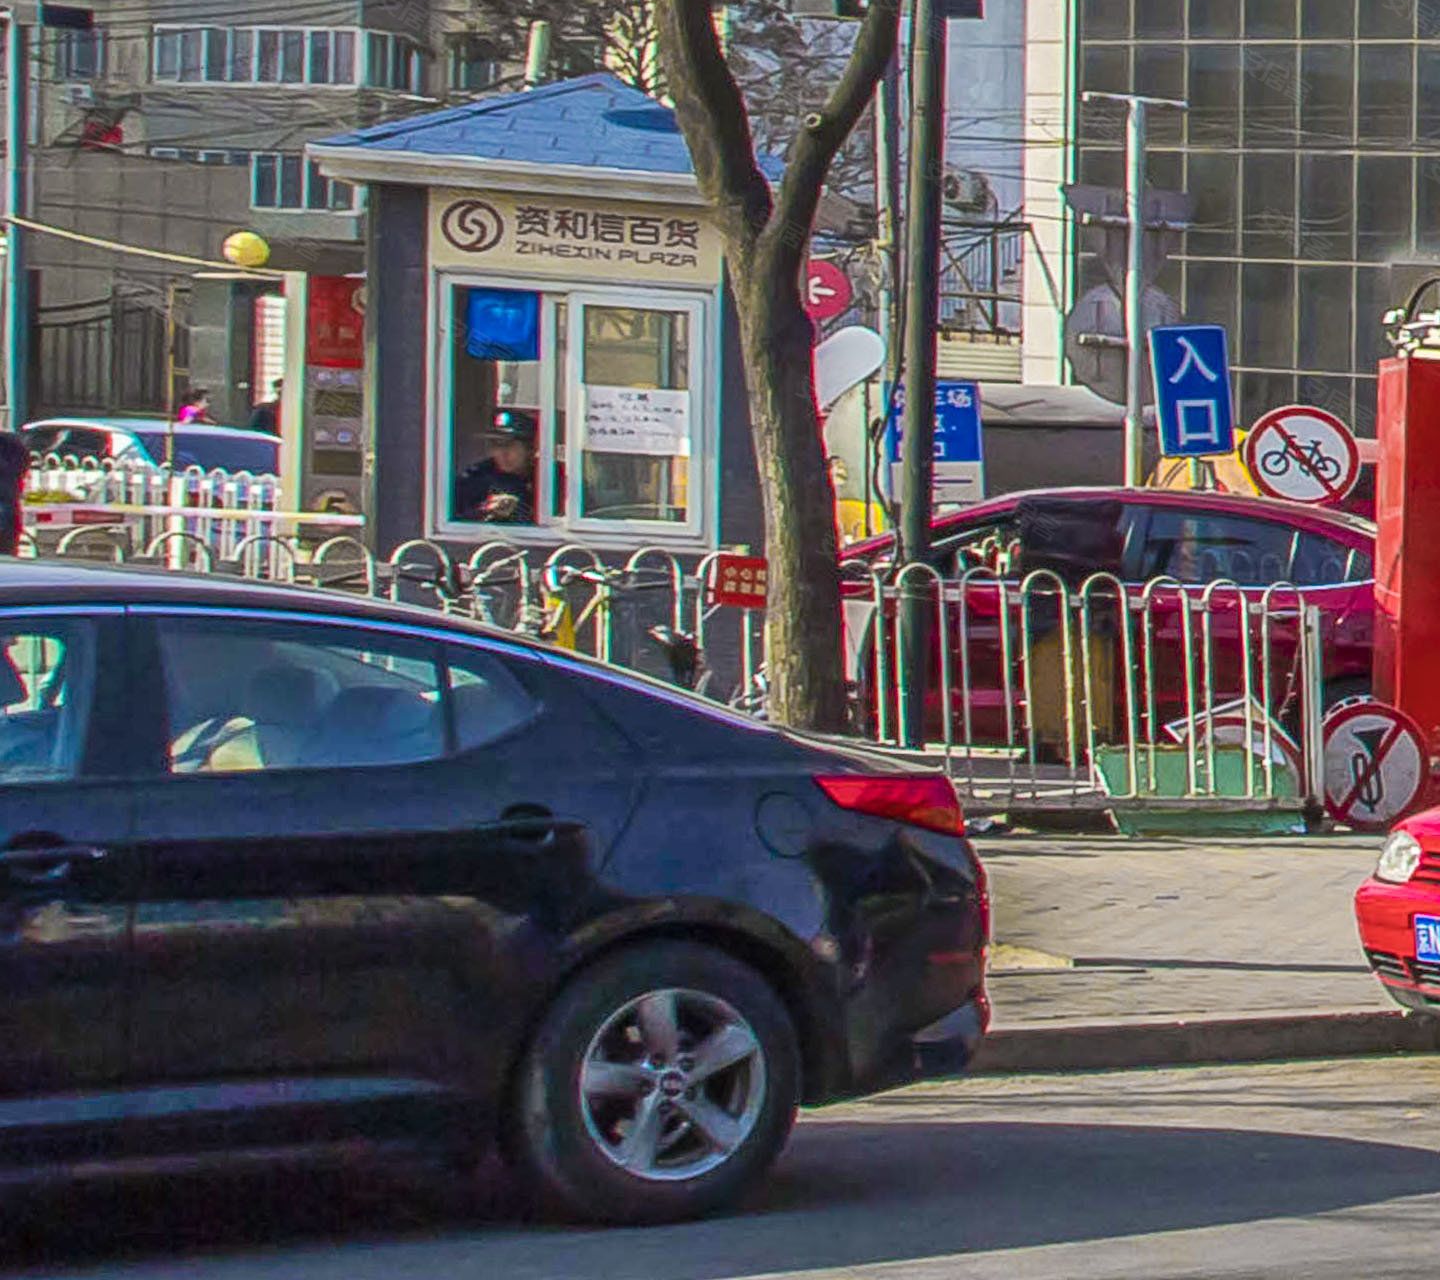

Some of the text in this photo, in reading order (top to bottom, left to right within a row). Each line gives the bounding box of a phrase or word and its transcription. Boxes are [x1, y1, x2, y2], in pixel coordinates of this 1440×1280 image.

[516, 206, 699, 249] 资和信百货
[515, 241, 697, 267] ZIHEXIN PLAZA
[1169, 336, 1219, 445] 入口
